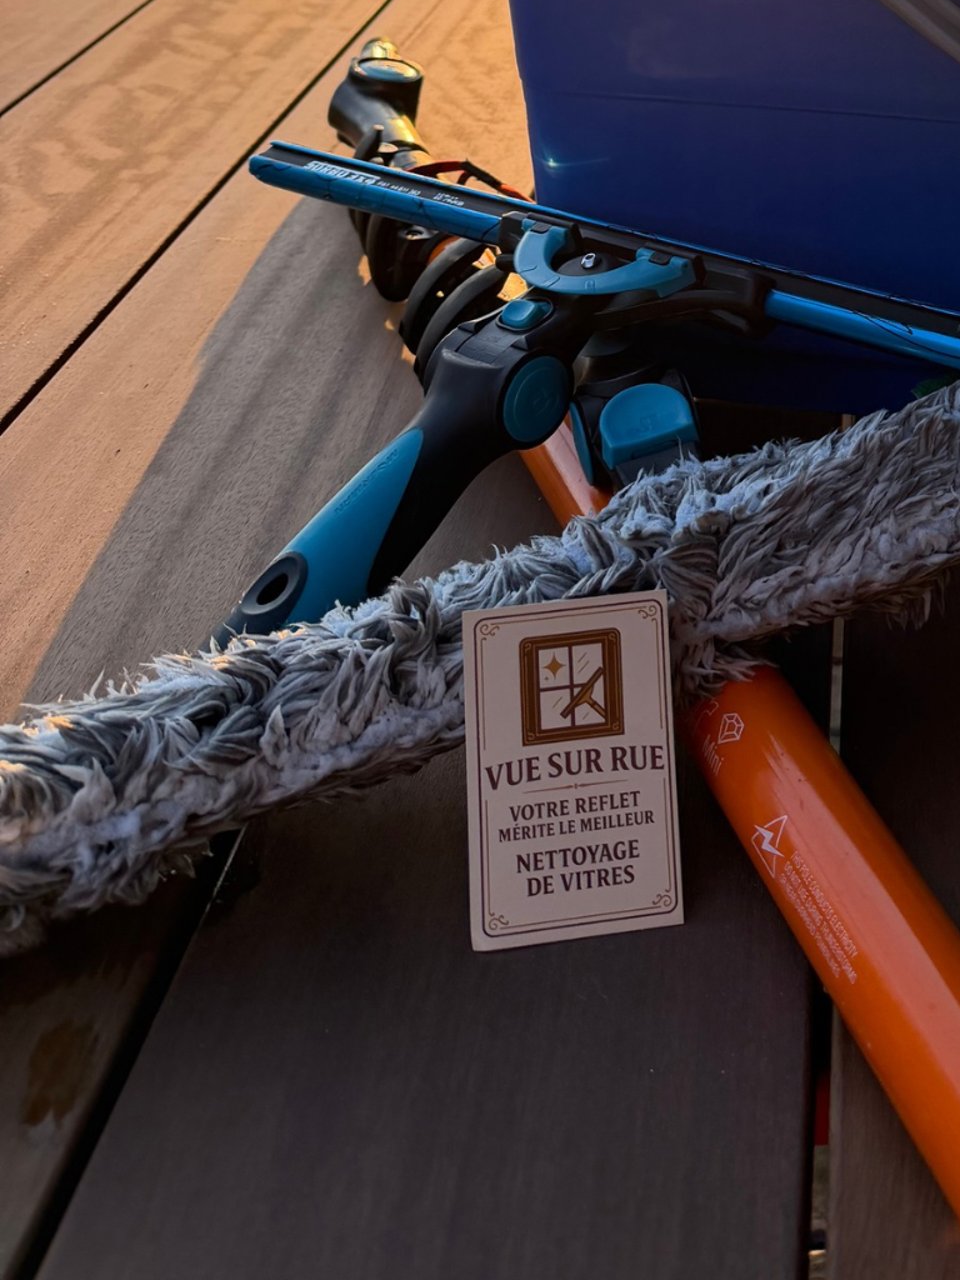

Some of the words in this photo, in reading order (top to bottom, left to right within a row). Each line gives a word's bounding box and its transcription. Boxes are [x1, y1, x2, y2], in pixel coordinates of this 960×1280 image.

[485, 756, 541, 791] VUE
[547, 749, 604, 779] SUR
[610, 745, 665, 772] RUE
[702, 734, 724, 776] Mini
[509, 800, 570, 822] VOTRE
[575, 791, 641, 815] REFLET
[498, 821, 556, 843] MÉRITE
[559, 821, 577, 836] LE
[580, 810, 655, 834] MEILLEUR
[516, 839, 641, 874] NETTOYAGE
[526, 875, 555, 897] DE
[560, 865, 635, 892] VITRES
